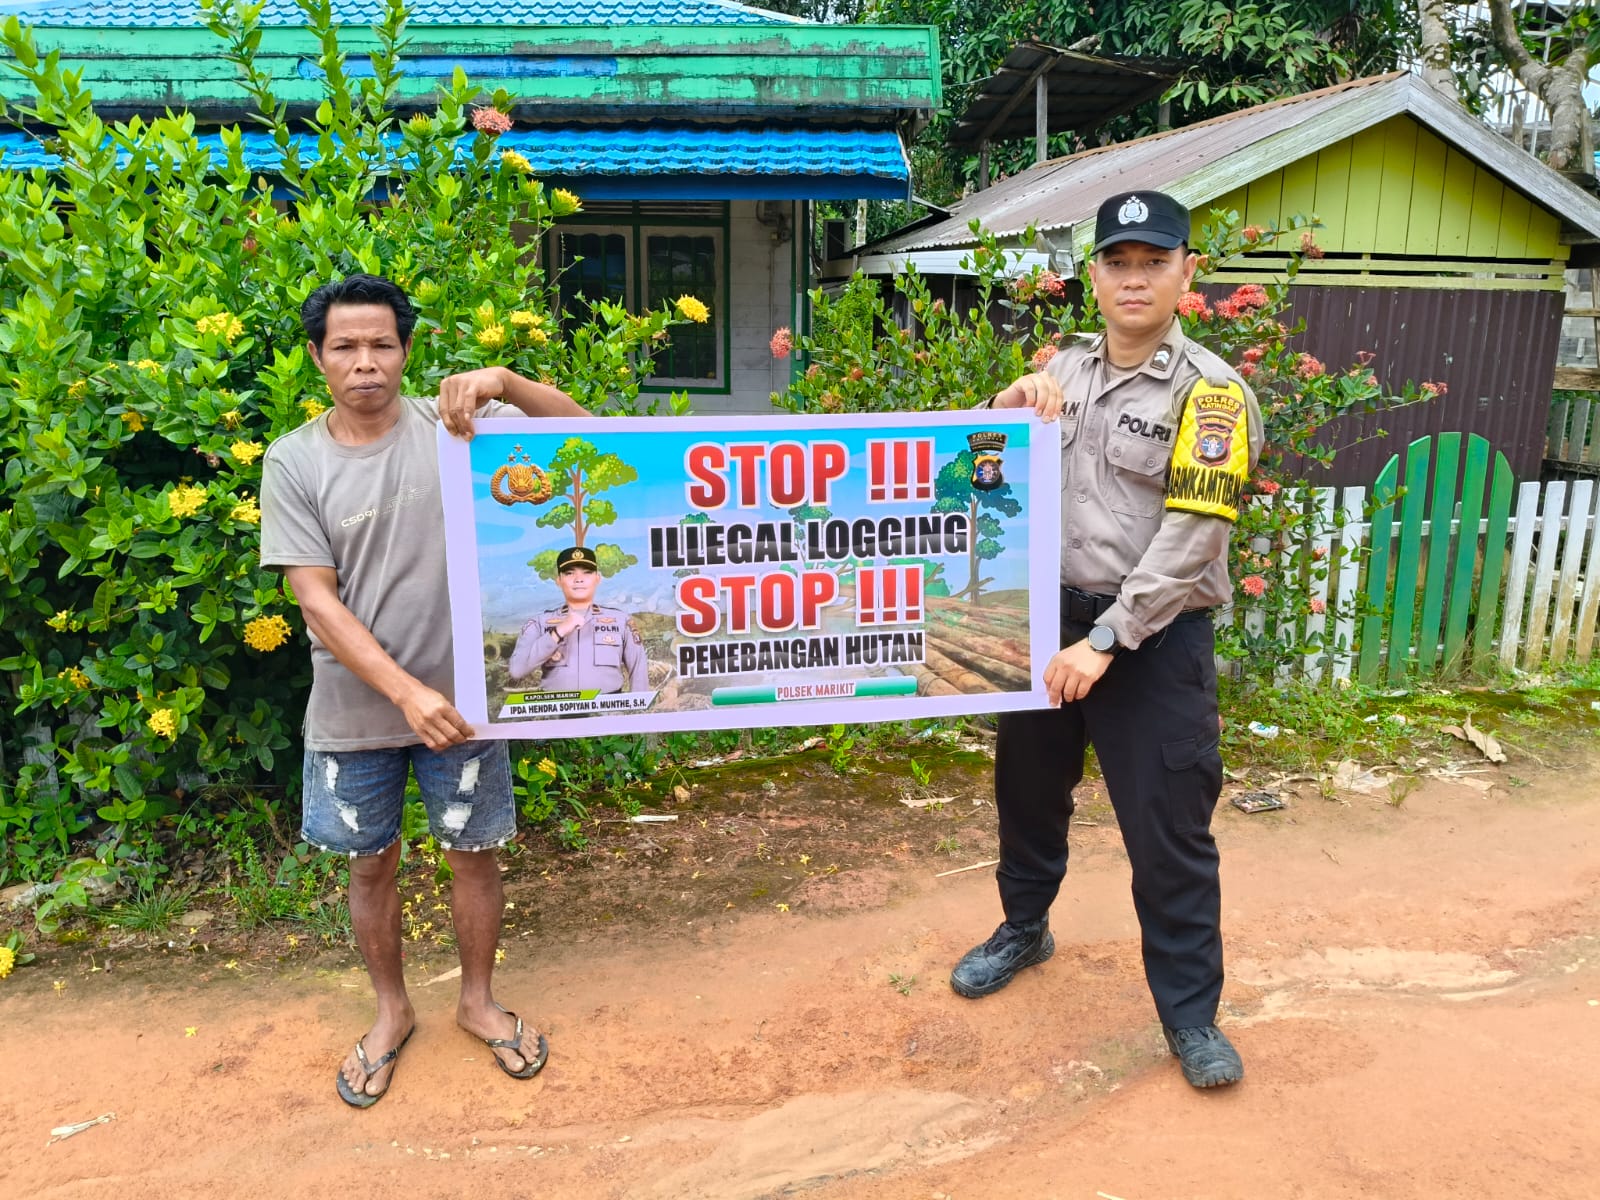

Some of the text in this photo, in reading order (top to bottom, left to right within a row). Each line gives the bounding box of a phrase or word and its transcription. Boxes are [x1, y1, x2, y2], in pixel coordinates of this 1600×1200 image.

[1117, 412, 1172, 442] POLRI
[687, 439, 932, 509] STOP !!!
[649, 513, 969, 568] ILLEGAL LOGGING
[678, 566, 922, 635] STOP !!!
[594, 625, 619, 633] POLRI
[679, 631, 923, 676] PENEBANGAN HUTAN
[510, 706, 527, 715] IPDA
[528, 704, 558, 713] HENDRA
[559, 702, 590, 711] SOPIYAN
[591, 701, 598, 710] D.
[633, 699, 646, 707] S.H.
[777, 682, 855, 699] POLSEK MARIKIT
